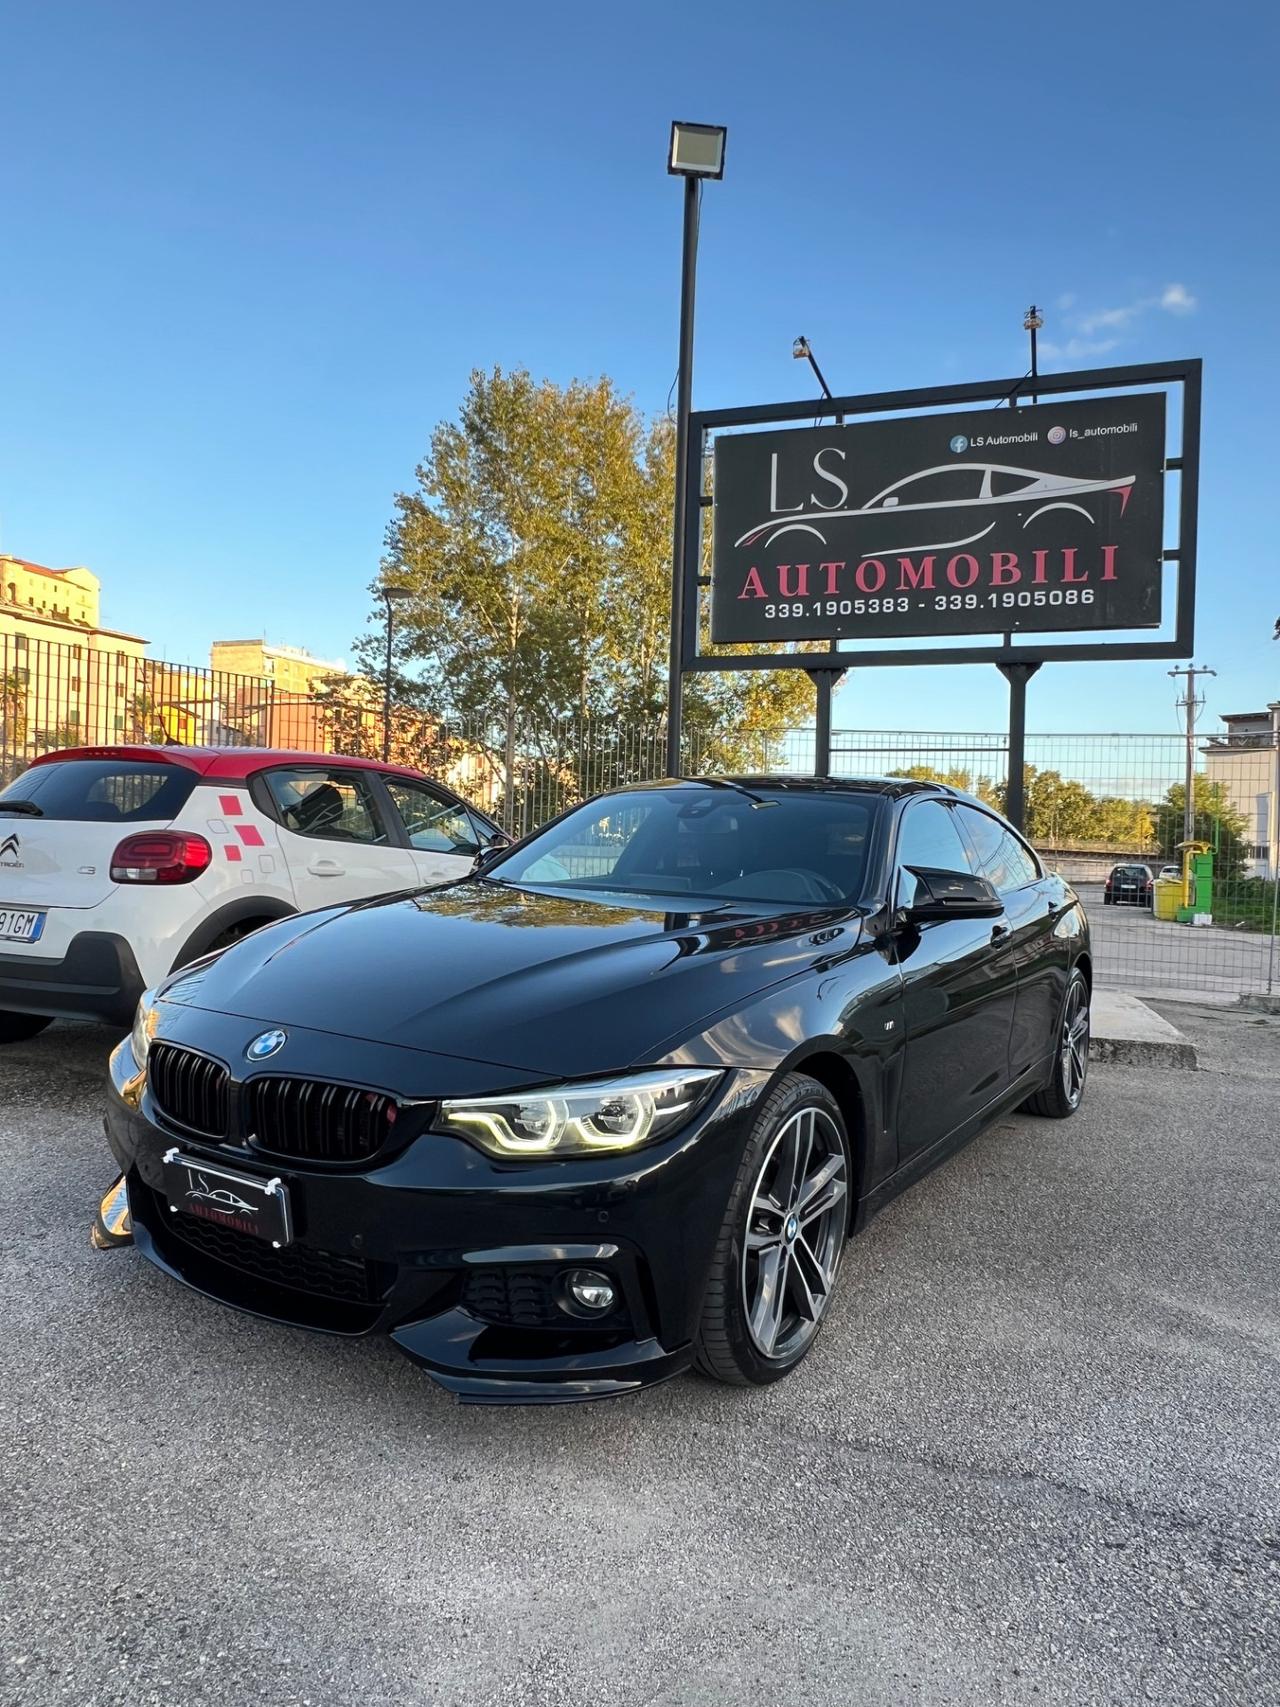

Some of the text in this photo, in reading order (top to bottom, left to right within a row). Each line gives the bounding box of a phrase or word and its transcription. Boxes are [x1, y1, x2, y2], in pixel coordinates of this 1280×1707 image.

[970, 431, 1038, 447] LS Automobili
[1069, 422, 1138, 440] ls_automobili
[737, 545, 1119, 600] AUTOMOBILI
[764, 597, 909, 619] 339.1905383
[934, 588, 1095, 611] 339.1905086
